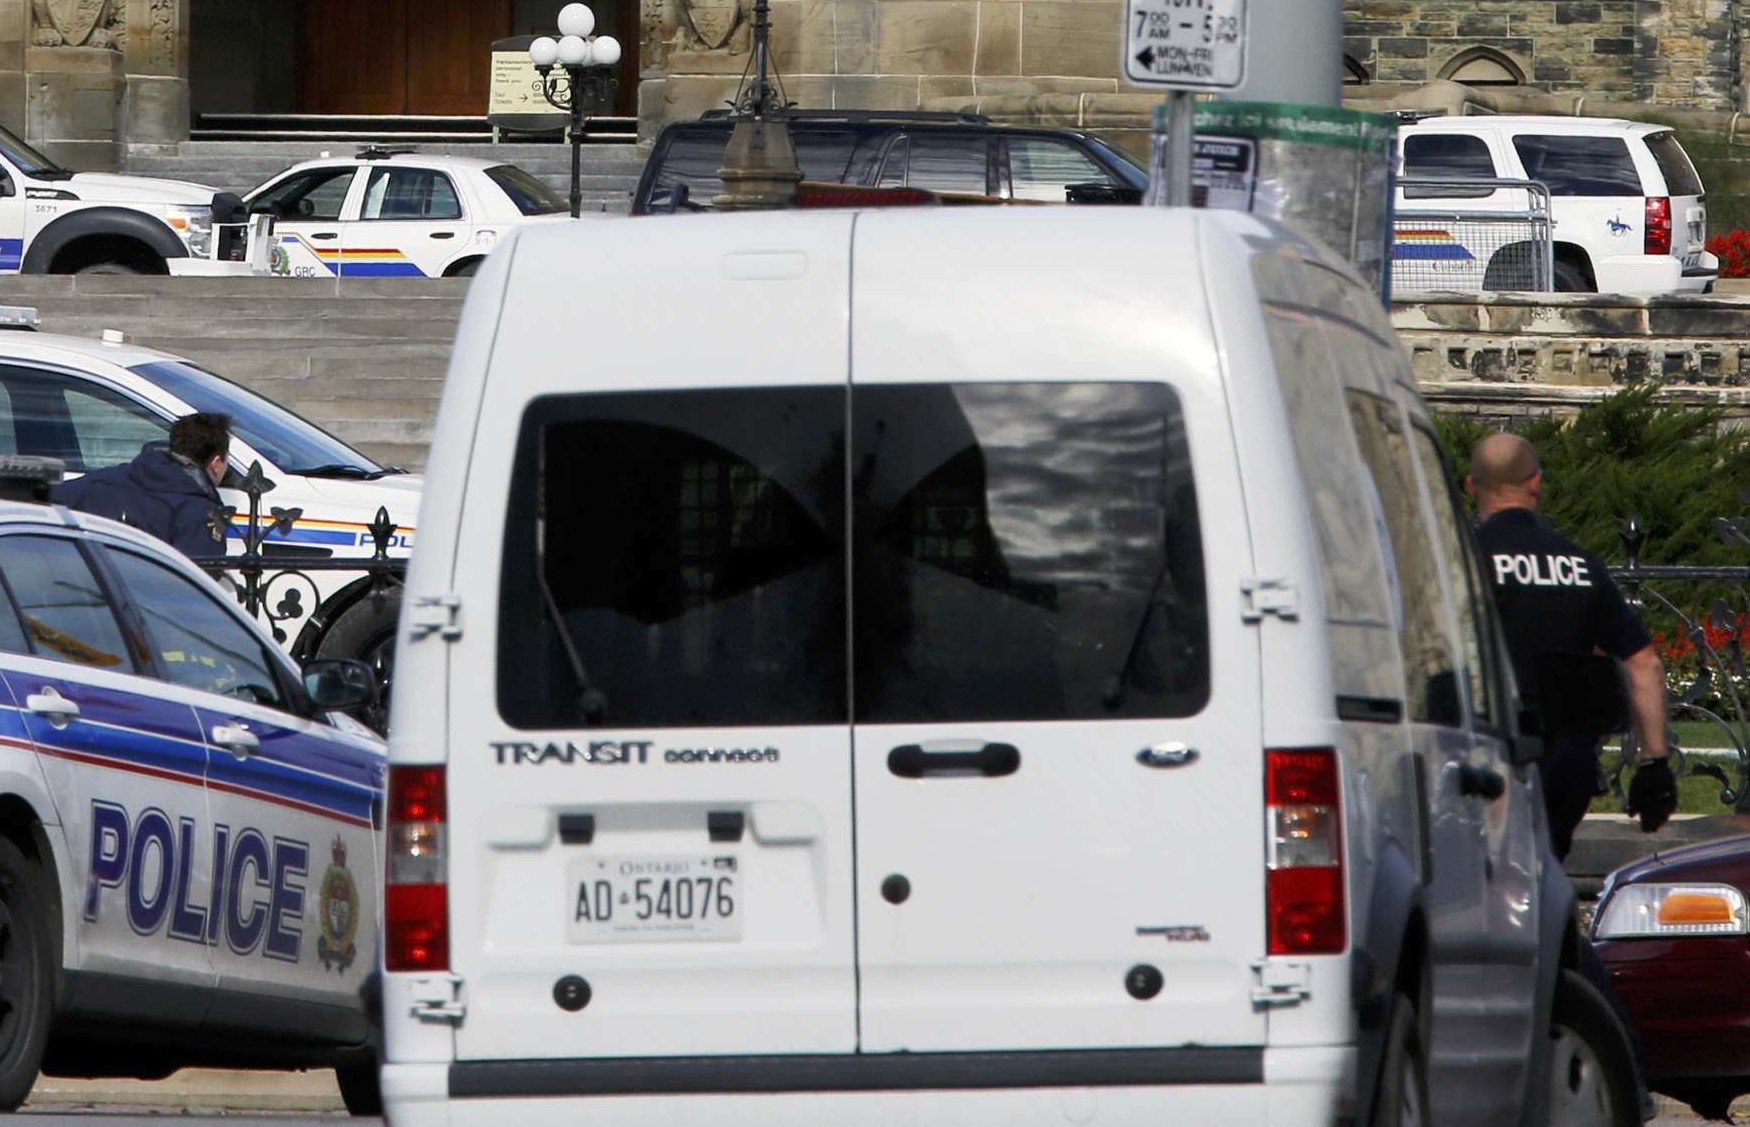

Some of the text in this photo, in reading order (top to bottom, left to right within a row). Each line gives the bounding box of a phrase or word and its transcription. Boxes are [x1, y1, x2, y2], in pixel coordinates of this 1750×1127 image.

[294, 266, 317, 277] GRC
[1493, 554, 1592, 586] POLICE
[490, 741, 654, 764] TRANSIT
[619, 858, 690, 875] ONTARIO
[83, 798, 310, 964] POLICE
[634, 876, 735, 920] 54076
